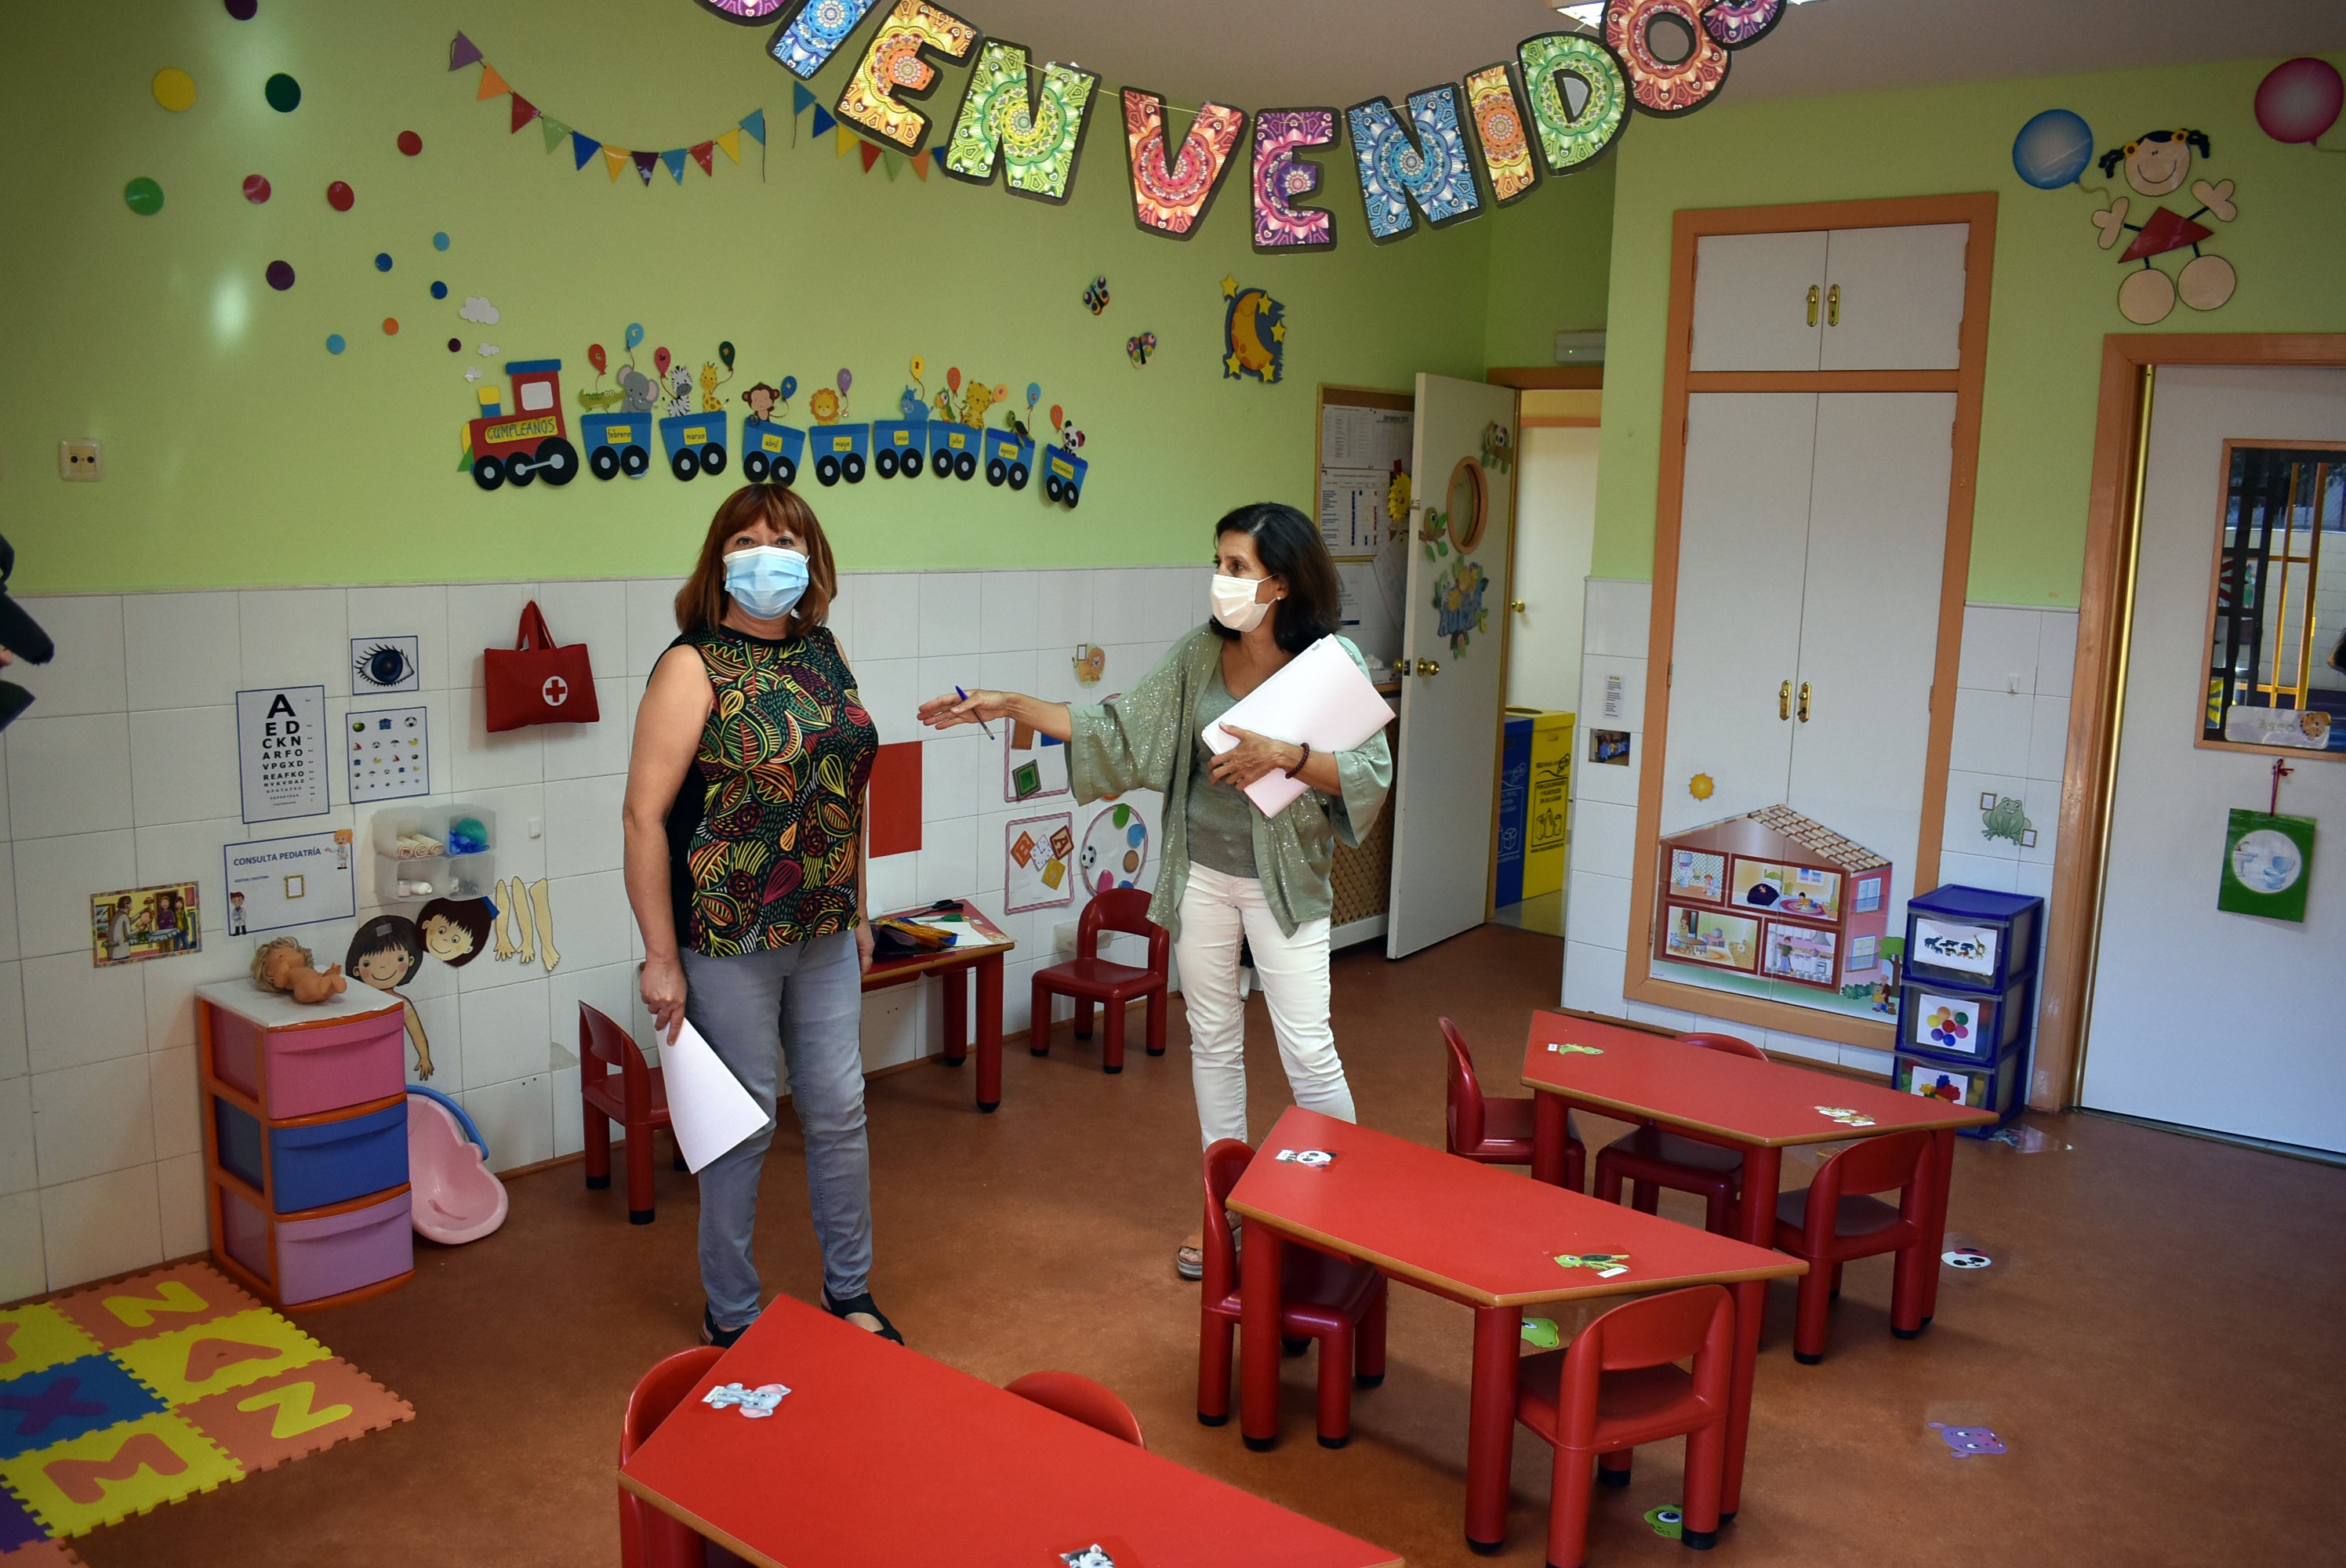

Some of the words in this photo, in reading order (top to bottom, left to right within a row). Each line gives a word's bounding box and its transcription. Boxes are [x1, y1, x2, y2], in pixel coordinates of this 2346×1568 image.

[487, 419, 555, 439] CUMPLEAÑOS
[607, 428, 631, 439] febrero
[764, 436, 779, 449] abril
[835, 441, 851, 451] mayo
[267, 694, 296, 719] A
[234, 854, 278, 866] CONSULTA
[279, 847, 321, 860] PEDIATRÍA
